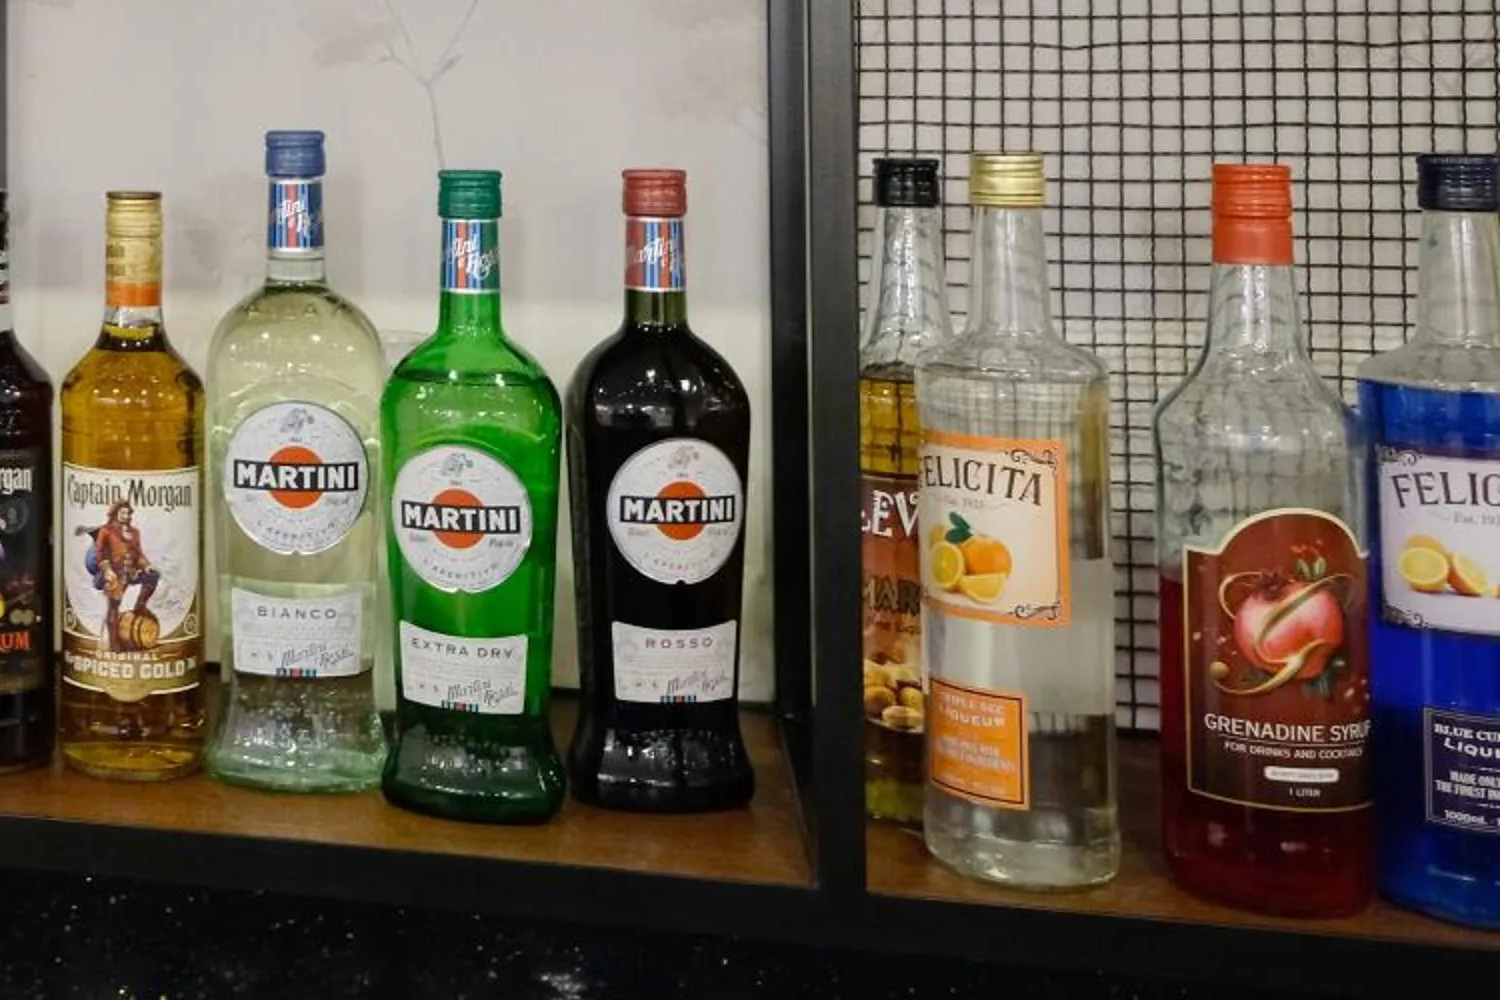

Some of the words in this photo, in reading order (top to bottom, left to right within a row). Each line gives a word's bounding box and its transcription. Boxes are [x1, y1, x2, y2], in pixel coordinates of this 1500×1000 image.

[237, 464, 356, 489] MARTINI
[920, 455, 1043, 507] ELICITA
[67, 475, 122, 509] Captain
[123, 480, 192, 511] Morgan
[1390, 471, 1500, 508] FELIC
[404, 503, 517, 532] MARTINI
[623, 498, 733, 522] MARTINI
[257, 605, 338, 620] BIANCO
[411, 637, 469, 657] EXTRA
[477, 647, 515, 659] DRY
[645, 637, 714, 649] ROSSO
[73, 659, 134, 679] SPICED
[139, 661, 185, 678] GOLD
[1203, 713, 1325, 743] GRENADINE
[1434, 723, 1474, 739] BLUE
[1223, 741, 1247, 753] FOR
[1294, 749, 1316, 759] AND
[1443, 737, 1500, 759] LIQUE
[1478, 775, 1500, 788] ONL
